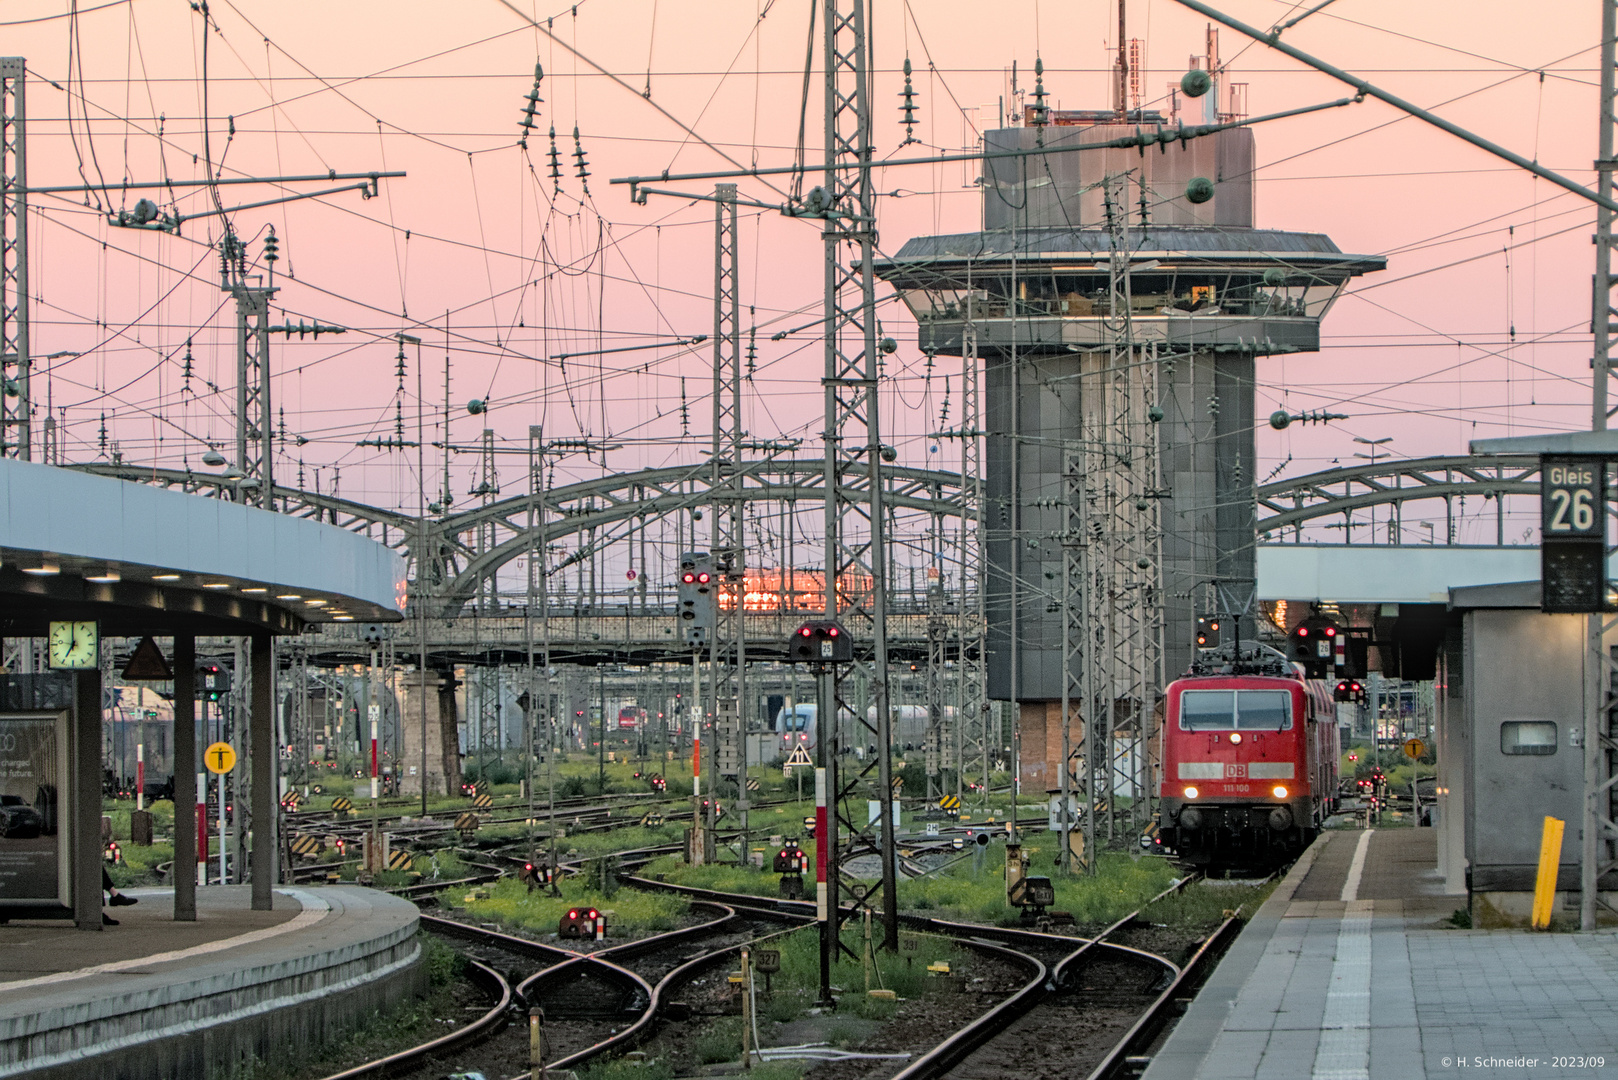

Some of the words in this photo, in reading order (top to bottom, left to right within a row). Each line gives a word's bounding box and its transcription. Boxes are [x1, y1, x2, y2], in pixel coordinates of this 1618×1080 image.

[1551, 467, 1592, 485] Gleis
[1551, 488, 1593, 530] 26
[1320, 644, 1328, 652] 26
[794, 751, 804, 762] 11
[8, 769, 34, 778] future.
[1227, 764, 1245, 778] DB
[1223, 784, 1234, 792] 111
[1236, 784, 1250, 792] 100
[903, 940, 918, 950] 331
[760, 954, 776, 965] 327
